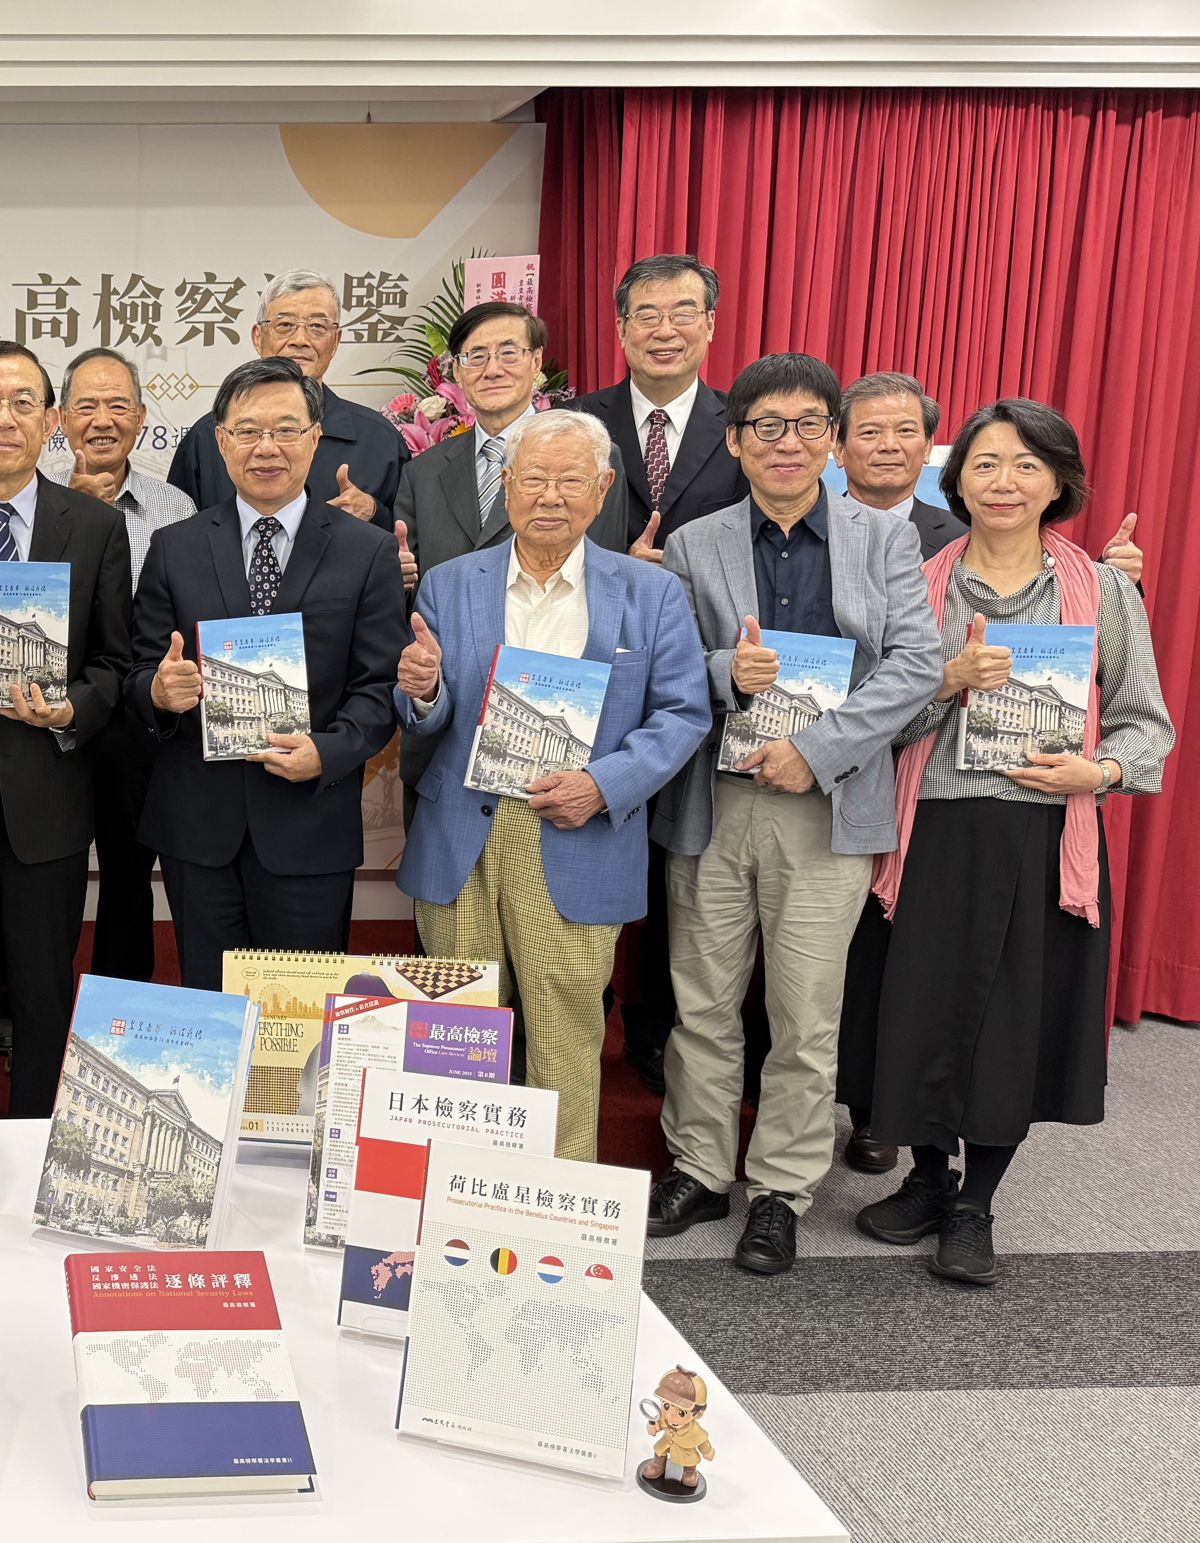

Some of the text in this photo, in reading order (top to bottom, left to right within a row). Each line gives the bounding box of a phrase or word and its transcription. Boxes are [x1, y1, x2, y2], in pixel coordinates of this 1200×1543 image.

[429, 1023, 499, 1045] 最高檢察
[467, 1046, 498, 1063] 論壇
[389, 1091, 527, 1128] 日本檢察實務
[248, 1121, 259, 1131] 01
[390, 1115, 524, 1139] JAPAN PROSECUTORIAL PRACTICE
[449, 1174, 622, 1220] 荷比盧星檢察實務
[446, 1195, 483, 1209] Prosecutorial
[484, 1202, 507, 1213] Practice
[525, 1209, 548, 1220] Benelux
[549, 1213, 577, 1225] Countries
[590, 1220, 620, 1232] Singapore
[90, 1264, 156, 1273] 國家安全法
[164, 1273, 252, 1289] 逐條評釋
